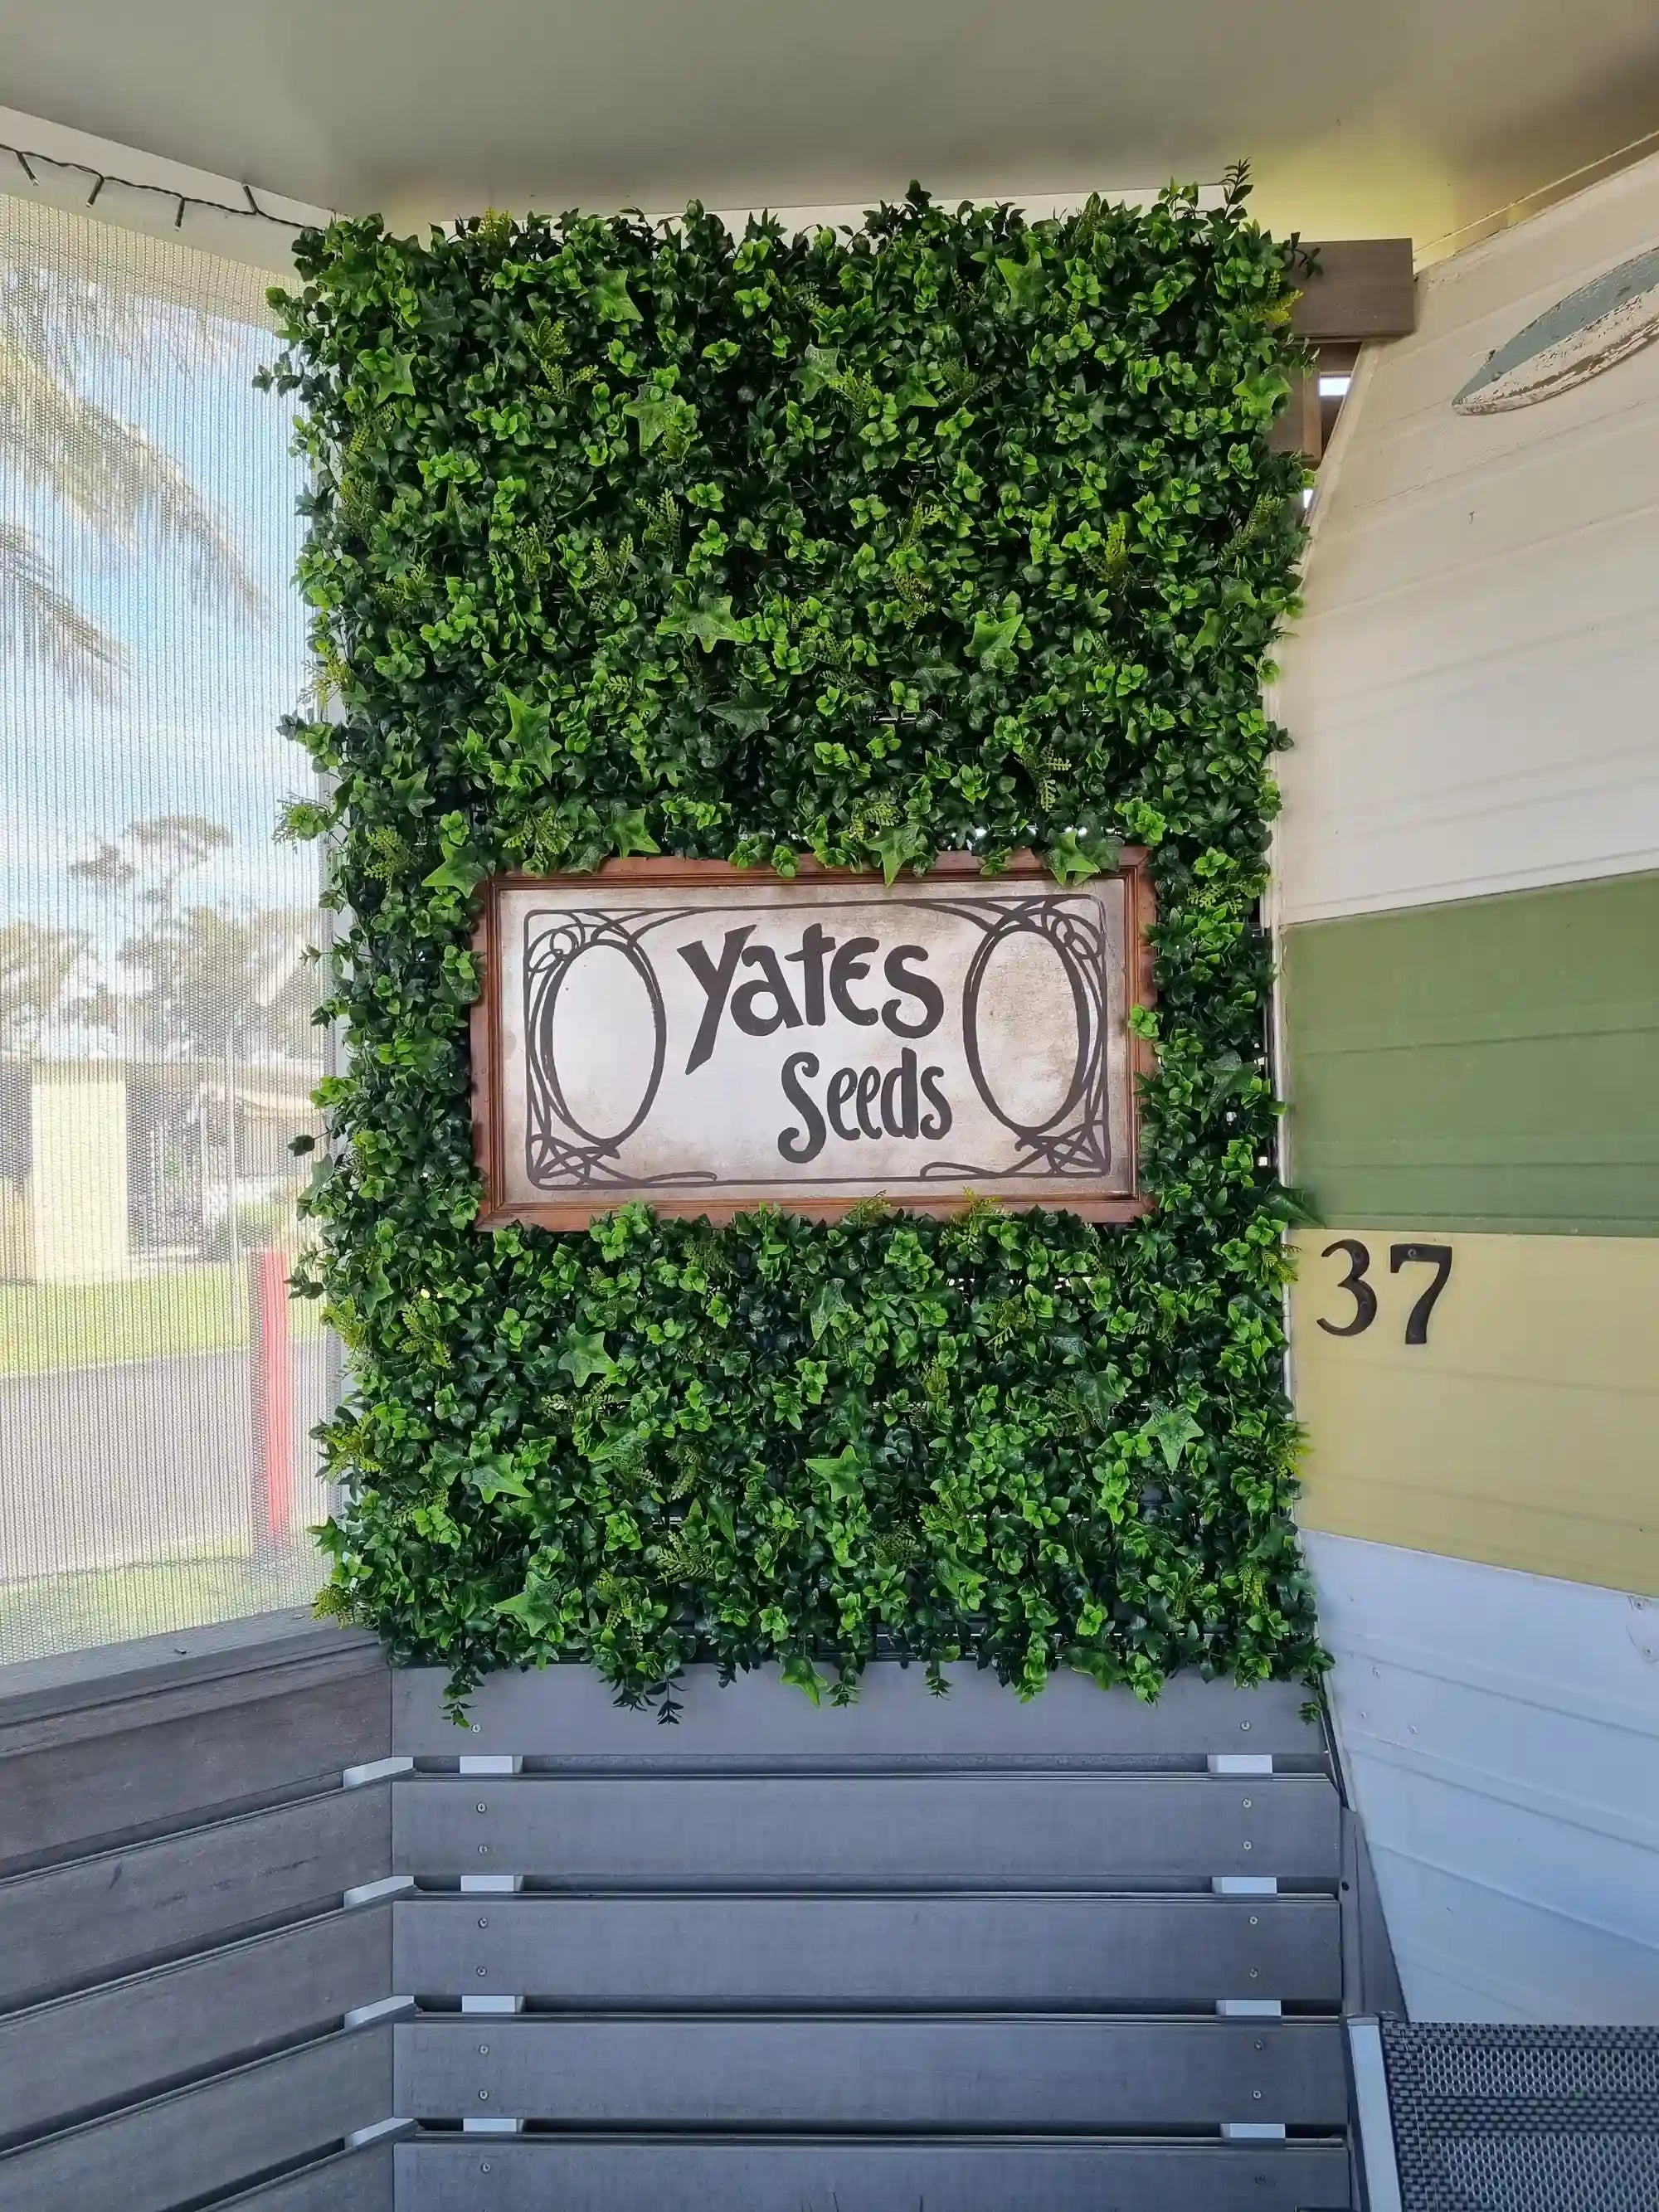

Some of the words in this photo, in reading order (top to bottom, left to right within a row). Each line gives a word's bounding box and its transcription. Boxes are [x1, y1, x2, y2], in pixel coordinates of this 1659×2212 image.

[677, 923, 944, 1075] Yates
[778, 1047, 953, 1164] Seeds
[1316, 1238, 1452, 1344] 37
